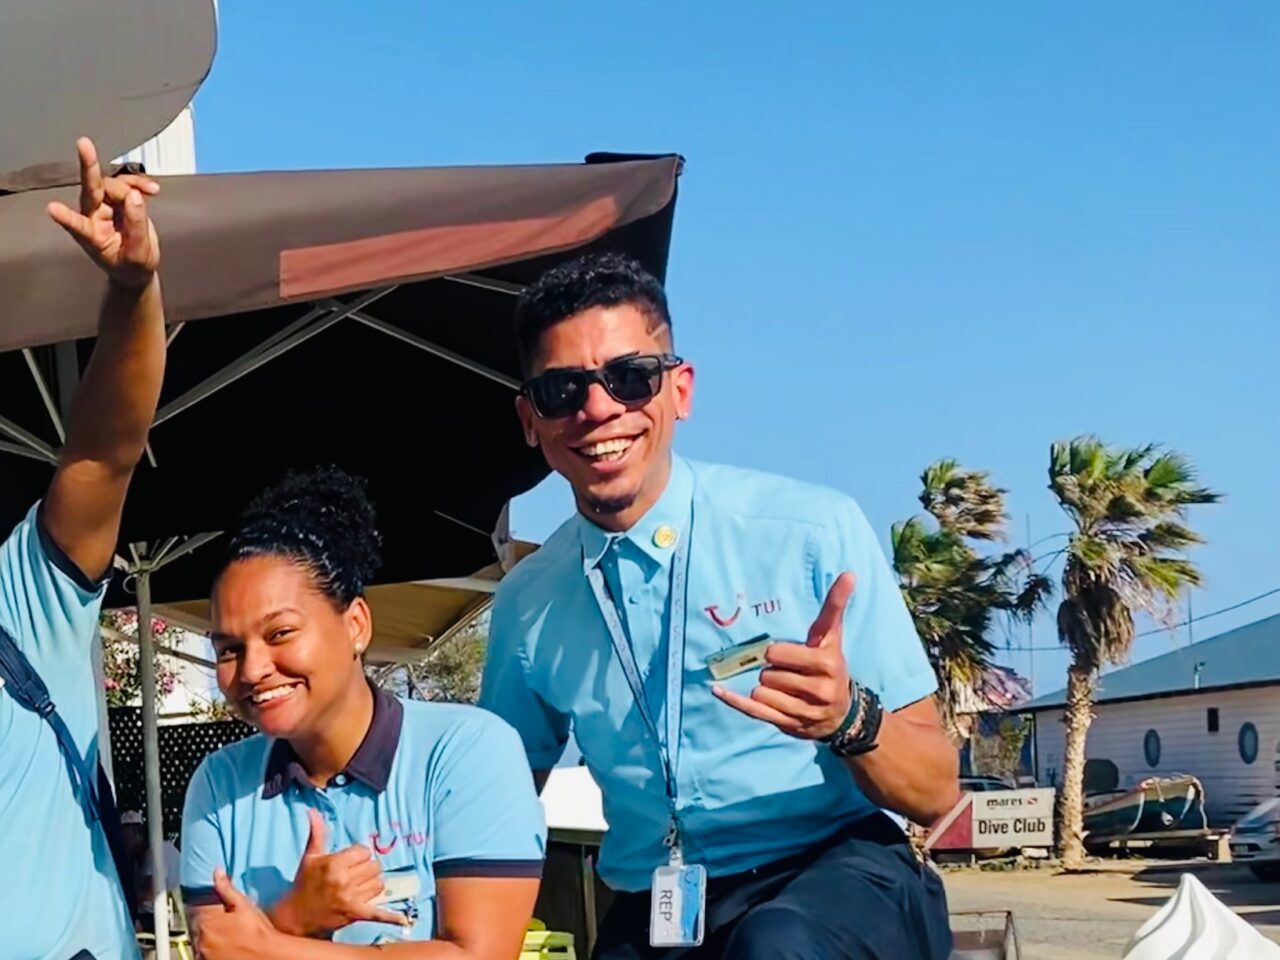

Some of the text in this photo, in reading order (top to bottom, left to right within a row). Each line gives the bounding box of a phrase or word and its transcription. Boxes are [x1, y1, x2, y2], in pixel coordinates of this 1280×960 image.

[752, 600, 781, 617] TUI
[978, 818, 1045, 834] Dive Club
[659, 889, 673, 922] REP
